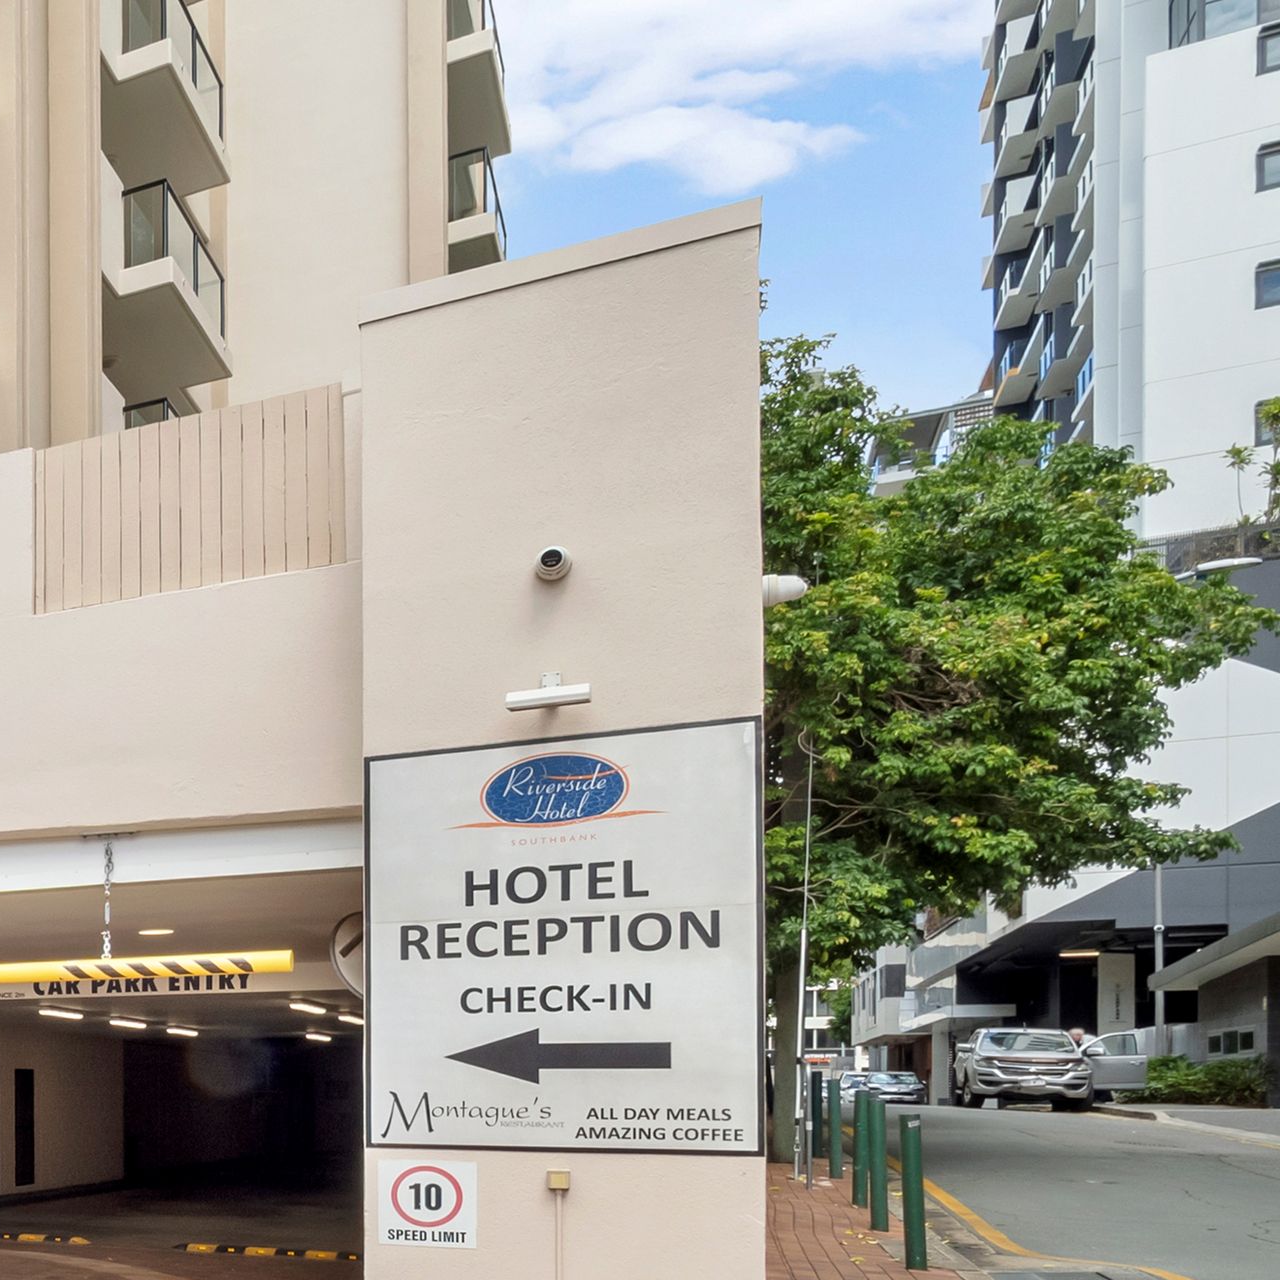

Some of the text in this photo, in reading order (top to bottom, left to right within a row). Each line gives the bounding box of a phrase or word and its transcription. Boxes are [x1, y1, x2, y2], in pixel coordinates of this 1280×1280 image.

[502, 762, 608, 798] Riverside
[514, 791, 591, 822] Hotel
[511, 833, 599, 847] SOUTHBANK
[463, 859, 650, 907] HOTEL
[399, 909, 721, 961] RECEPTION
[459, 982, 652, 1014] CHECK-IN
[381, 1090, 553, 1139] Montague's
[586, 1107, 732, 1122] ALL DAY MEALS
[575, 1126, 745, 1142] AMAZING COFFEE
[408, 1182, 443, 1212] 10
[387, 1228, 467, 1244] SPEED LIMIT
